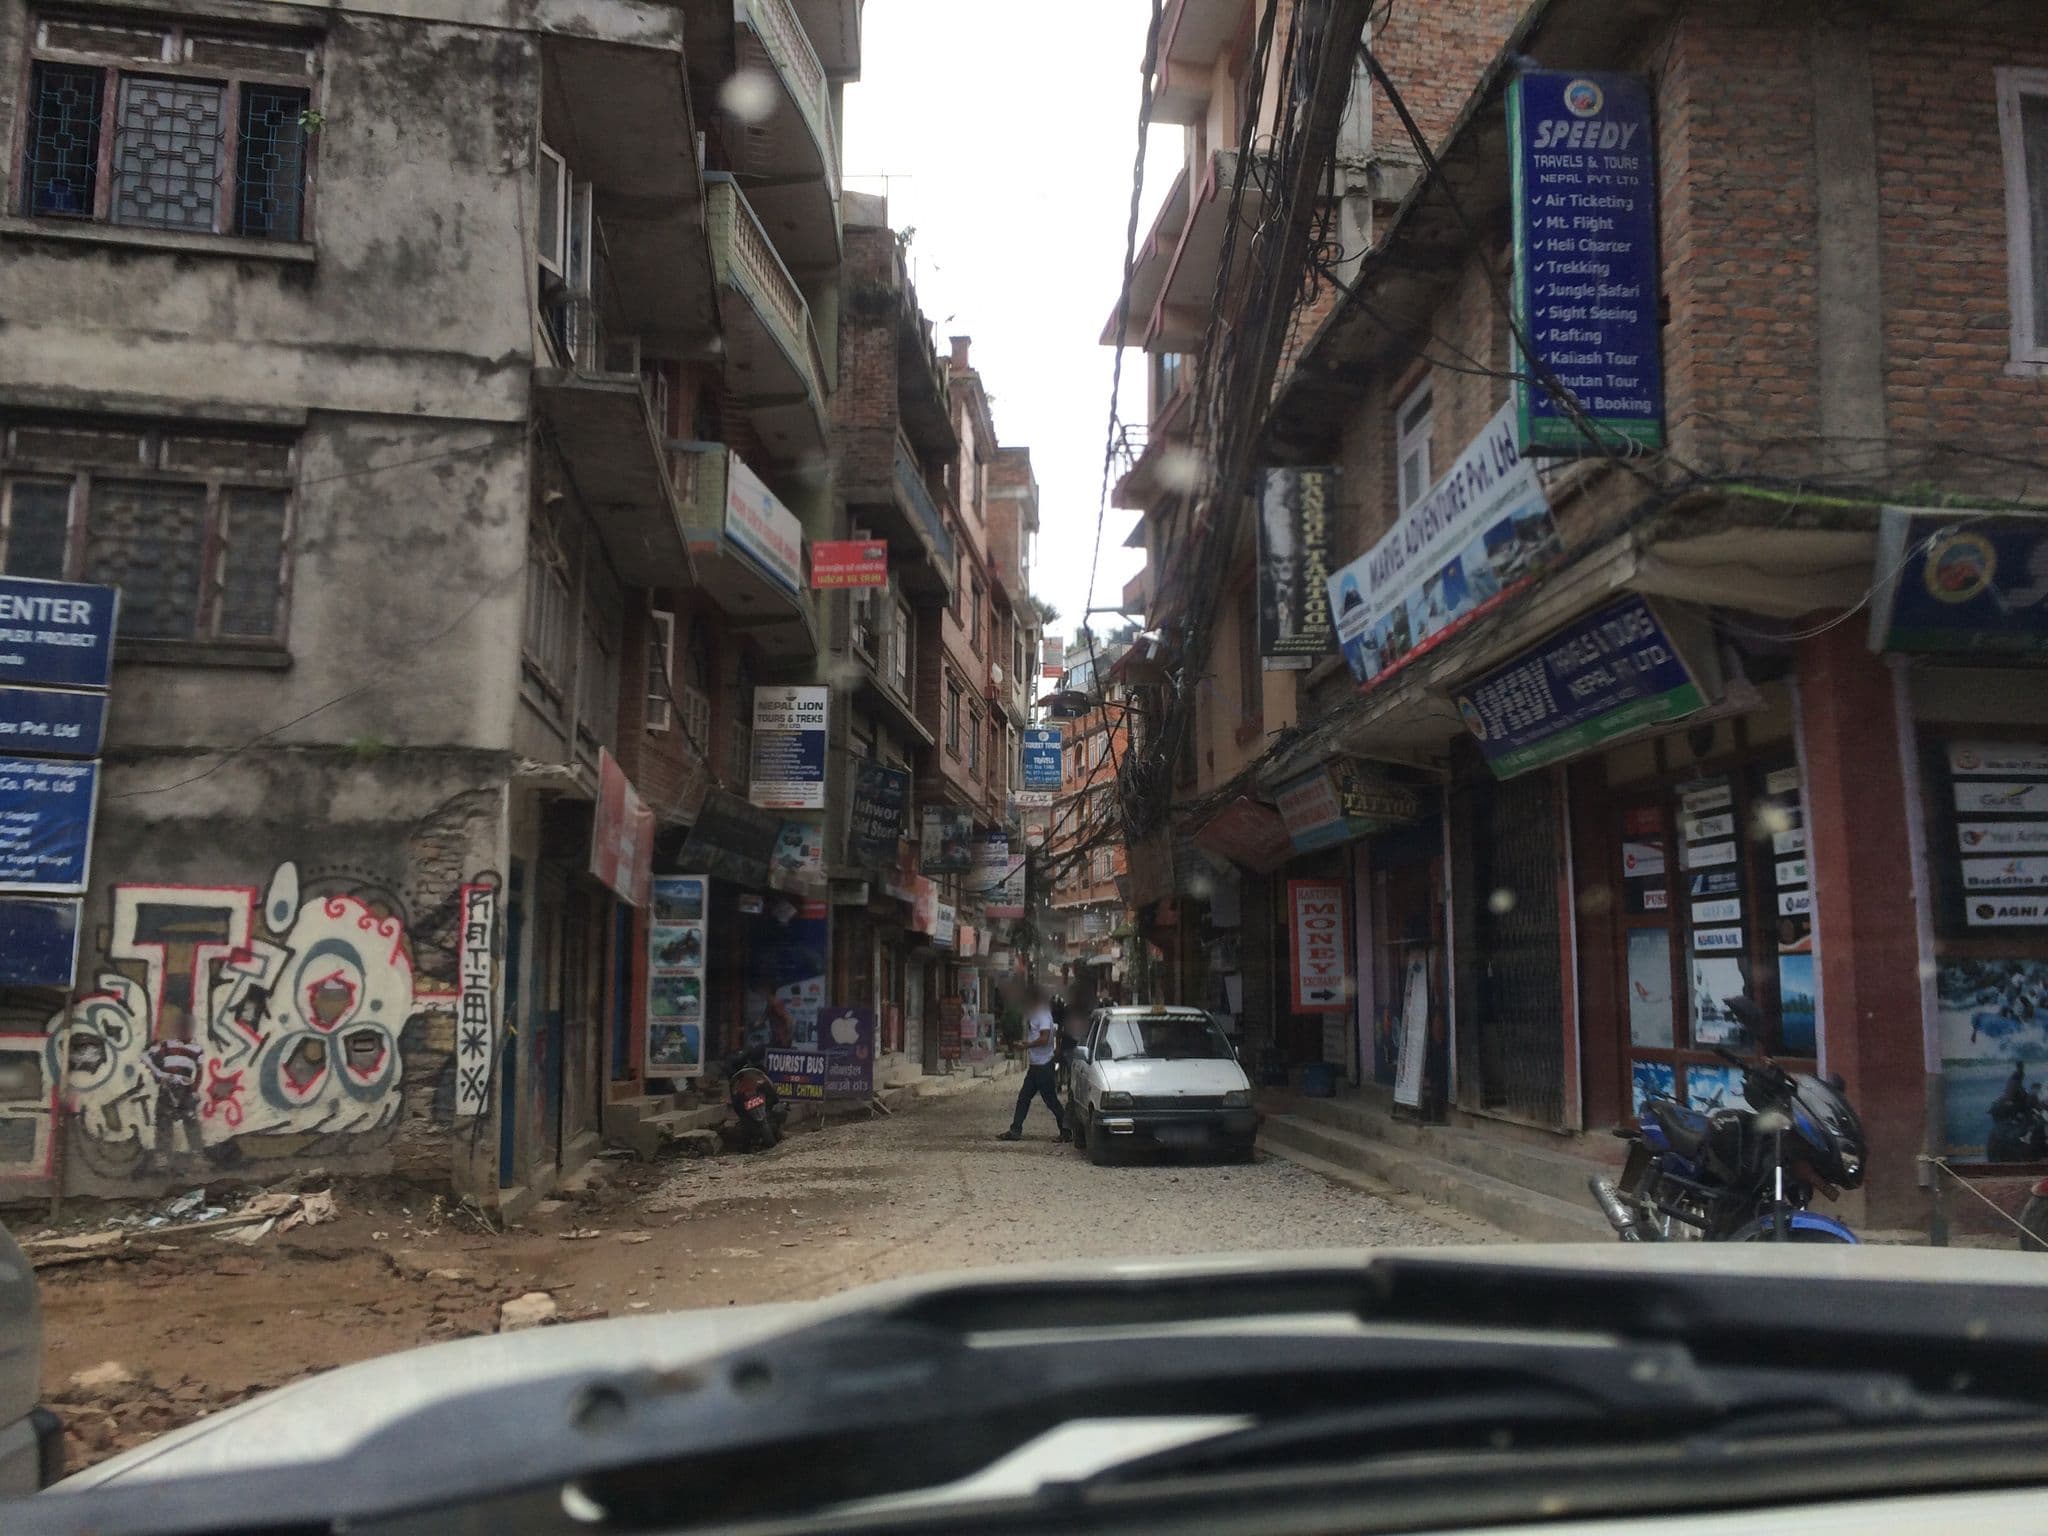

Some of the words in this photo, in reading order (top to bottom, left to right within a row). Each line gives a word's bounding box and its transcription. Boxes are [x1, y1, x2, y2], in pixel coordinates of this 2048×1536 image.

[1534, 120, 1638, 149] SPEEDY
[1534, 155, 1583, 168] TRAVELS
[1588, 156, 1598, 168] &
[1604, 156, 1638, 169] TOURS
[1540, 174, 1582, 183] NEPAL
[1545, 195, 1564, 206] Air
[1570, 194, 1633, 211] Ticketing
[1573, 216, 1614, 232] Flight
[1547, 239, 1575, 251] Heli
[1579, 239, 1632, 252] Charter
[1547, 260, 1610, 277] Trekking
[1548, 283, 1595, 299] Jungle
[1599, 284, 1640, 297] Safari
[1549, 306, 1586, 321] Sight
[1590, 306, 1638, 323] Seeing
[1550, 328, 1602, 344] Rafting
[1551, 351, 1602, 364] Kailash
[1606, 352, 1639, 365] Tour
[1606, 375, 1639, 388] Tour
[1594, 397, 1652, 413] Booking
[1405, 472, 1466, 556] ADVENTURE
[0, 594, 91, 625] ENTER
[758, 702, 794, 711] NEPAL
[797, 702, 823, 711] LION
[757, 715, 785, 723] TOURS
[796, 715, 823, 723] TREKS
[1968, 877, 2033, 886] Buddha
[1998, 907, 2037, 916] AGNI
[1303, 903, 1336, 975] MONEY
[768, 1054, 805, 1072] TOURIST
[807, 1056, 824, 1074] BUS
